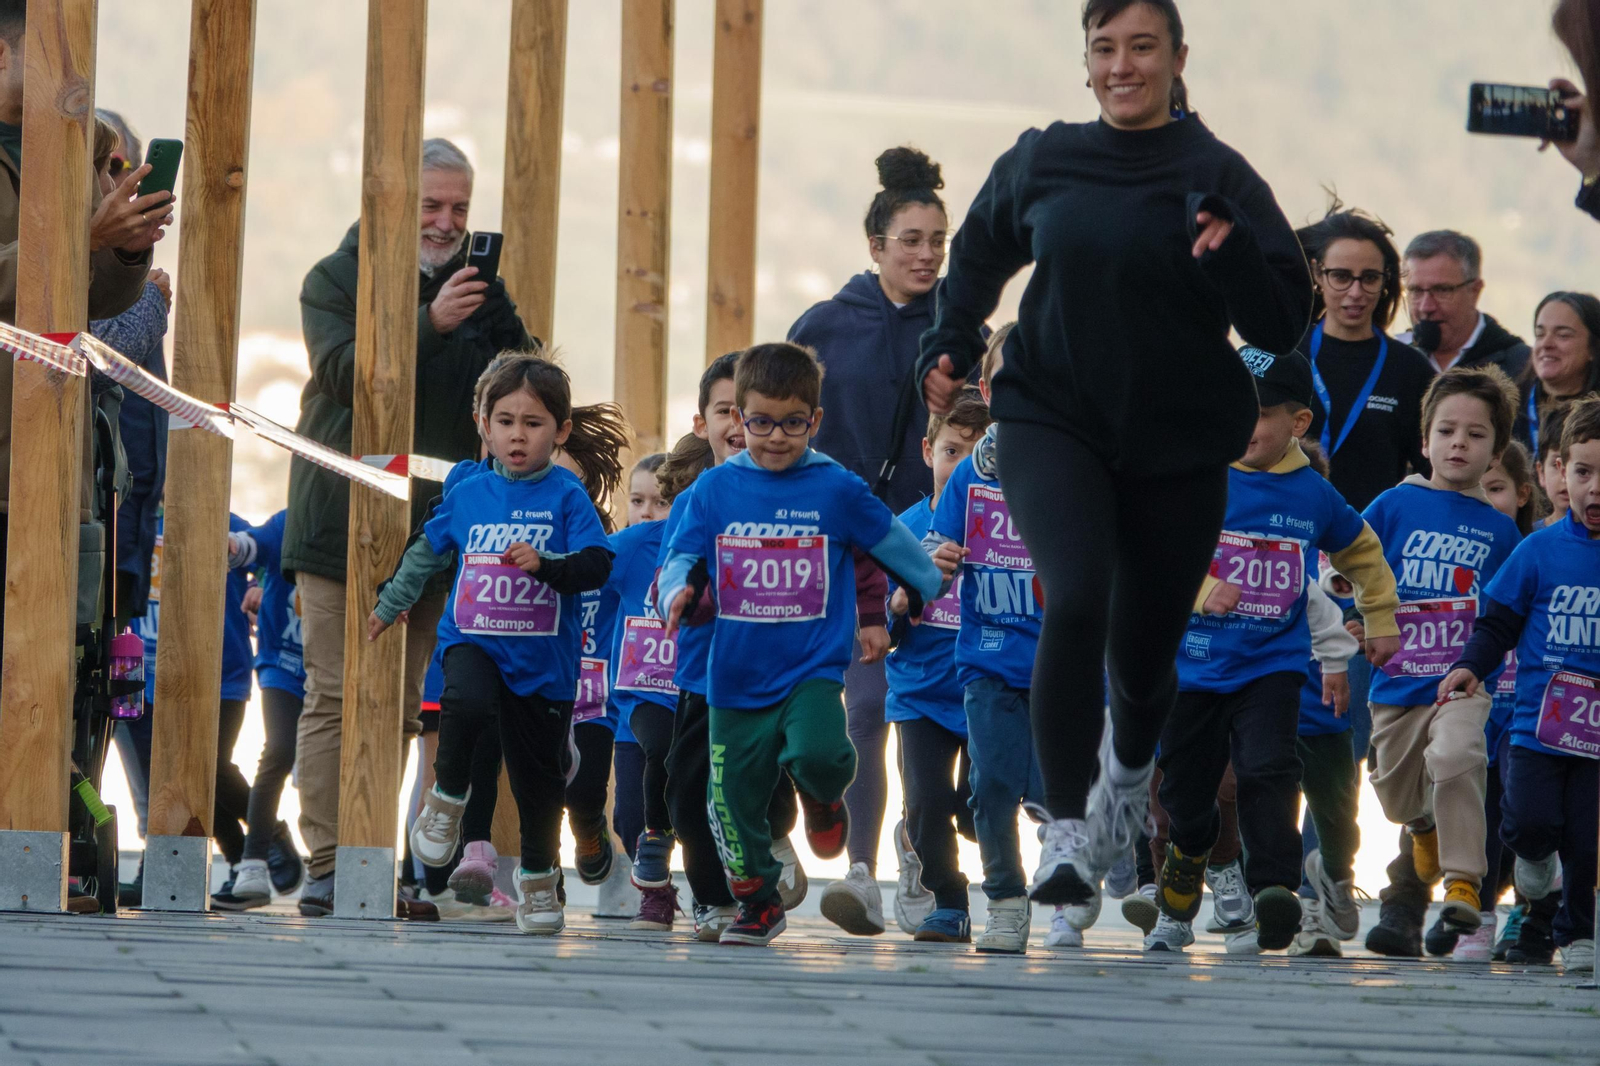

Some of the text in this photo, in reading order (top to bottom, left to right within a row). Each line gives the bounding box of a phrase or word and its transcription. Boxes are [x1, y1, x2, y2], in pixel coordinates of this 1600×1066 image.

[465, 523, 554, 553] CORRER
[990, 511, 1021, 541] 20
[985, 548, 1033, 568] Alcamp
[1402, 529, 1491, 570] CORRER
[742, 558, 811, 589] 2019
[1227, 556, 1290, 589] 2013
[476, 574, 549, 605] 2022
[973, 571, 1035, 615] XUNT
[473, 613, 535, 631] Alcampo
[740, 599, 802, 616] Alcampo
[931, 608, 961, 623] Alca
[1237, 601, 1281, 615] campo
[1402, 620, 1465, 651] 2012
[1546, 614, 1600, 647] XUNT
[643, 637, 675, 665] 20
[634, 672, 680, 690] Alcam
[1569, 696, 1600, 728] 20
[1558, 732, 1600, 753] Alcam
